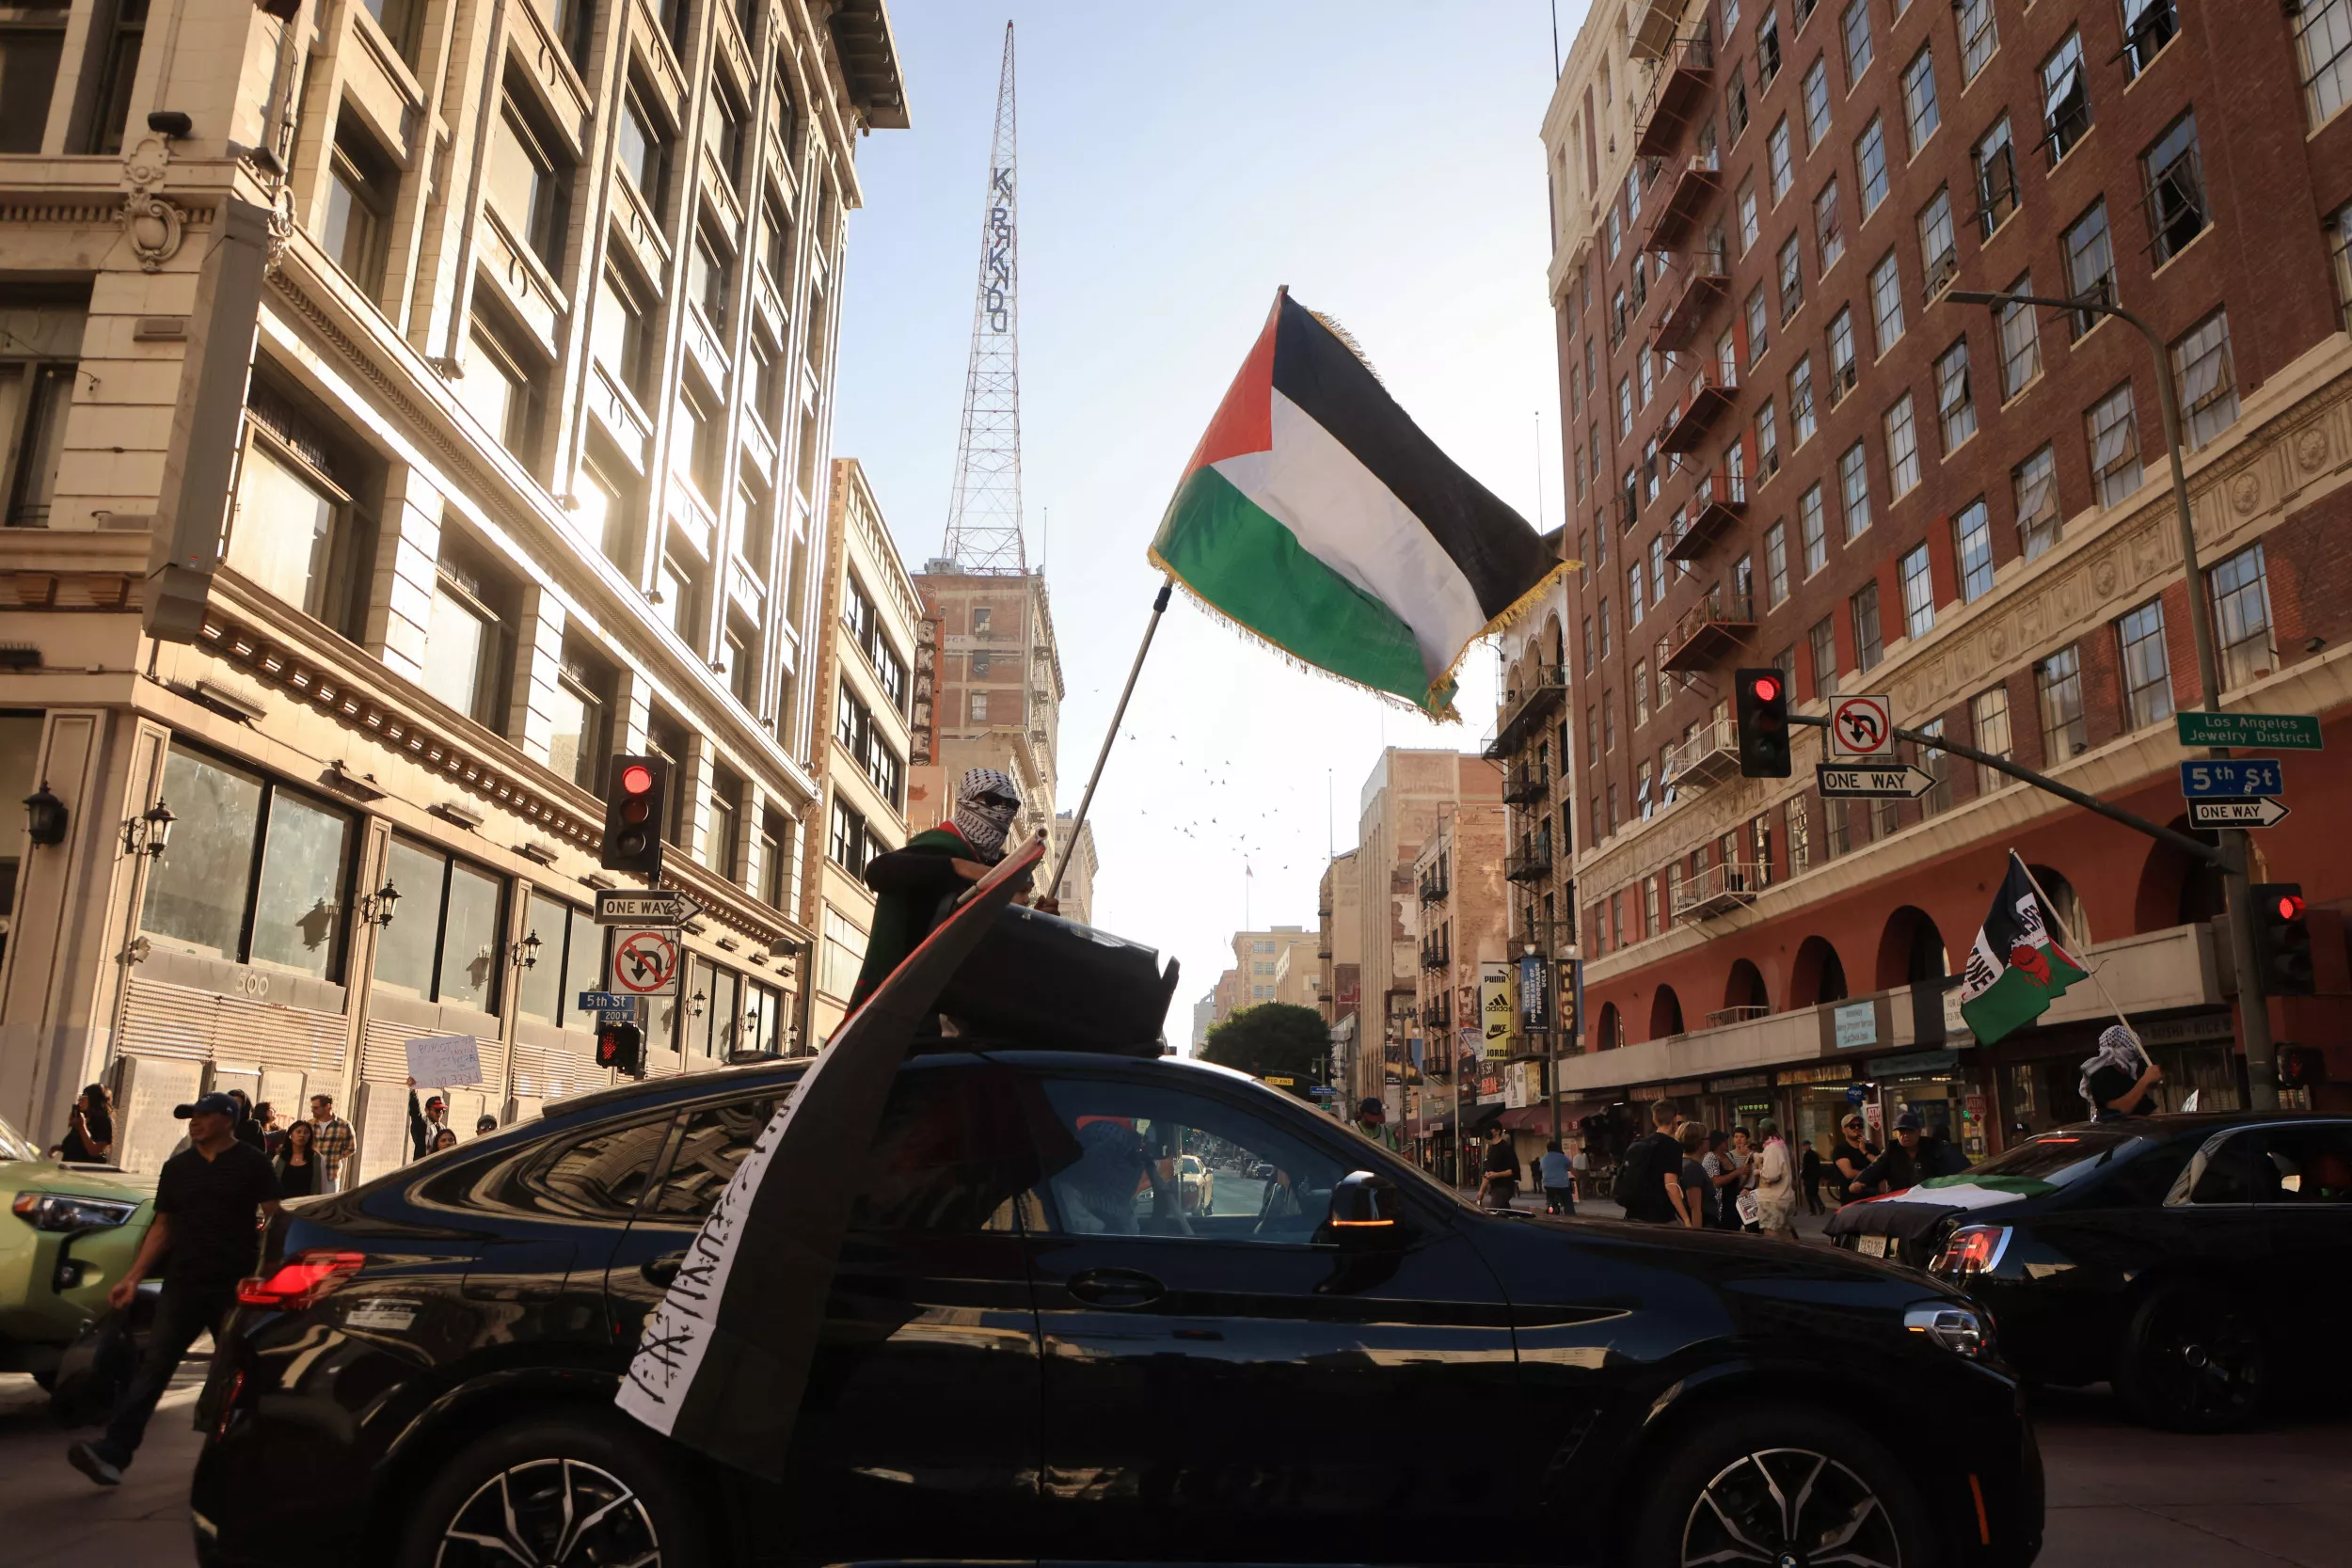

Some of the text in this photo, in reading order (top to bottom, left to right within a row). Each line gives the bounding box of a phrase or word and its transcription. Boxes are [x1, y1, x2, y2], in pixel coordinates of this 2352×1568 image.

[2205, 716, 2298, 730] Los Angeles
[2190, 730, 2311, 744] Jewelry District
[1826, 773, 1906, 789] ONE WAY
[2192, 766, 2273, 790] 5th St
[2201, 806, 2260, 818] ONE WAY
[606, 901, 671, 914] ONE WAY
[1529, 968, 1535, 977] OF
[234, 972, 269, 996] 500
[586, 994, 627, 1007] 5th St
[1562, 963, 1573, 1030] NIMOY
[605, 1011, 628, 1021] 200 W
[1490, 1024, 1507, 1033] NIKE
[1486, 1049, 1511, 1057] JORDA
[1968, 1098, 1984, 1108] ATM
[1867, 1107, 1881, 1117] ATM
